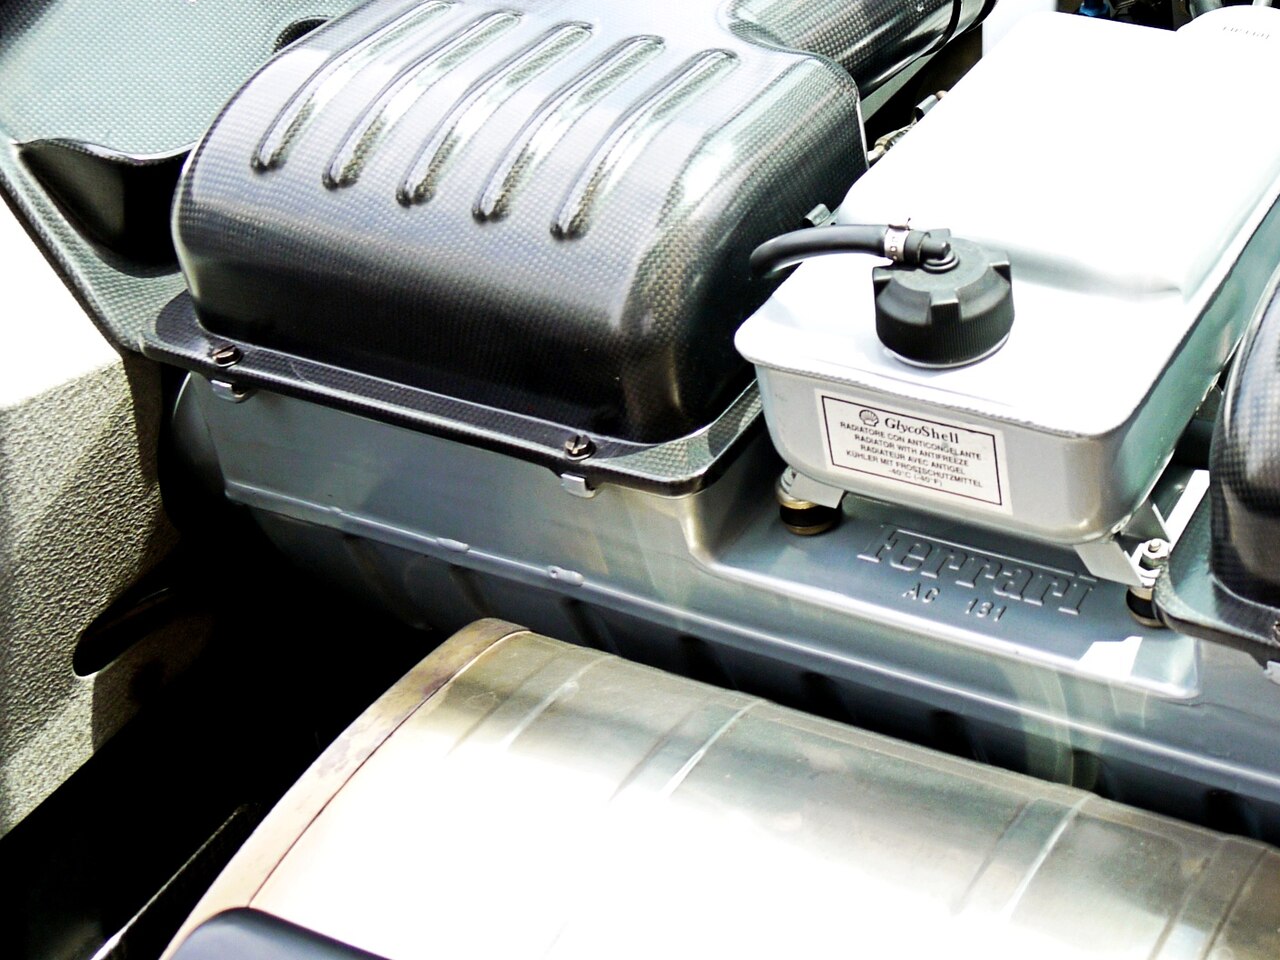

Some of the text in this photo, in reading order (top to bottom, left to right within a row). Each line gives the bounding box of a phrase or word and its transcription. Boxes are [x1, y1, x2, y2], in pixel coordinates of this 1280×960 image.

[840, 421, 982, 461] RADIATORE CON ANTICONGELANTE
[884, 417, 959, 444] GlycoShell
[854, 433, 969, 467] RADIATOR WITH ANTIFREEZE
[860, 443, 966, 476] RADIATEUR AVEC ANTIGEL
[880, 457, 893, 467] MIT
[857, 523, 1097, 616] Ferrari
[965, 596, 1008, 622] 131
